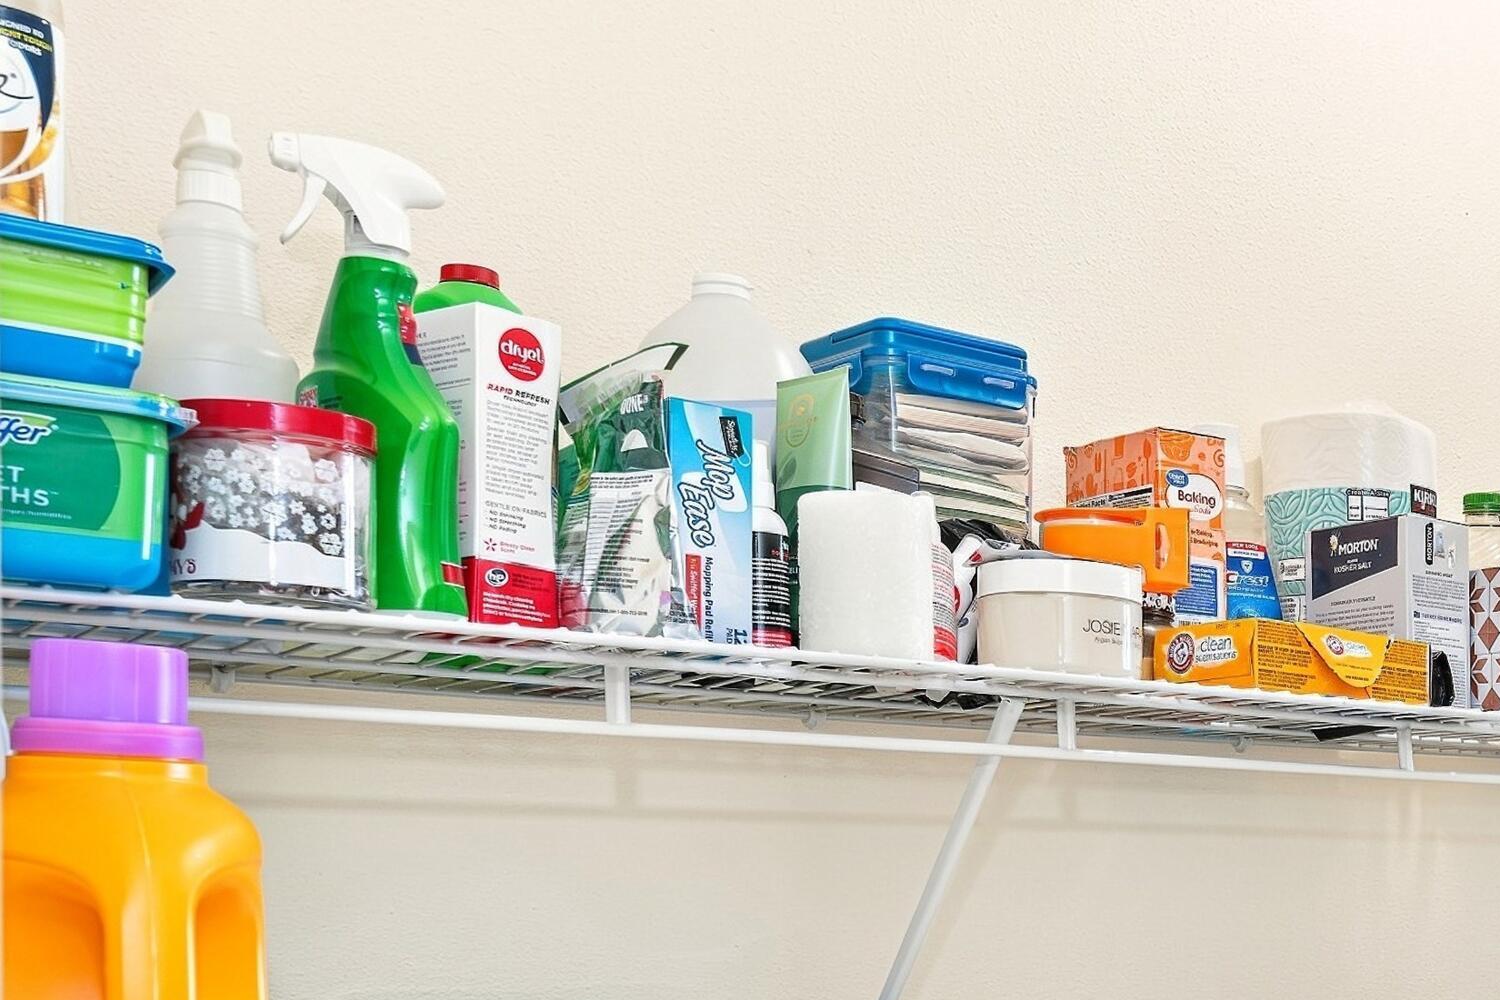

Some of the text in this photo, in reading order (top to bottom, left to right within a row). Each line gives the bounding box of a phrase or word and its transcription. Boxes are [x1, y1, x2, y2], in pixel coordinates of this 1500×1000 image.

[500, 339, 545, 364] dryel
[487, 383, 551, 406] RAPID REFRESH
[696, 439, 737, 501] Mop
[1177, 490, 1216, 508] Baking
[677, 482, 716, 549] Ease
[1338, 538, 1379, 556] MORTON
[1426, 525, 1434, 562] MORTON
[702, 556, 714, 597] Mopping
[1333, 562, 1372, 574] KOSHER SALT
[1226, 571, 1270, 588] Crest
[704, 599, 714, 617] Pad
[1082, 619, 1121, 636] JOSIE
[1200, 637, 1232, 653] clean
